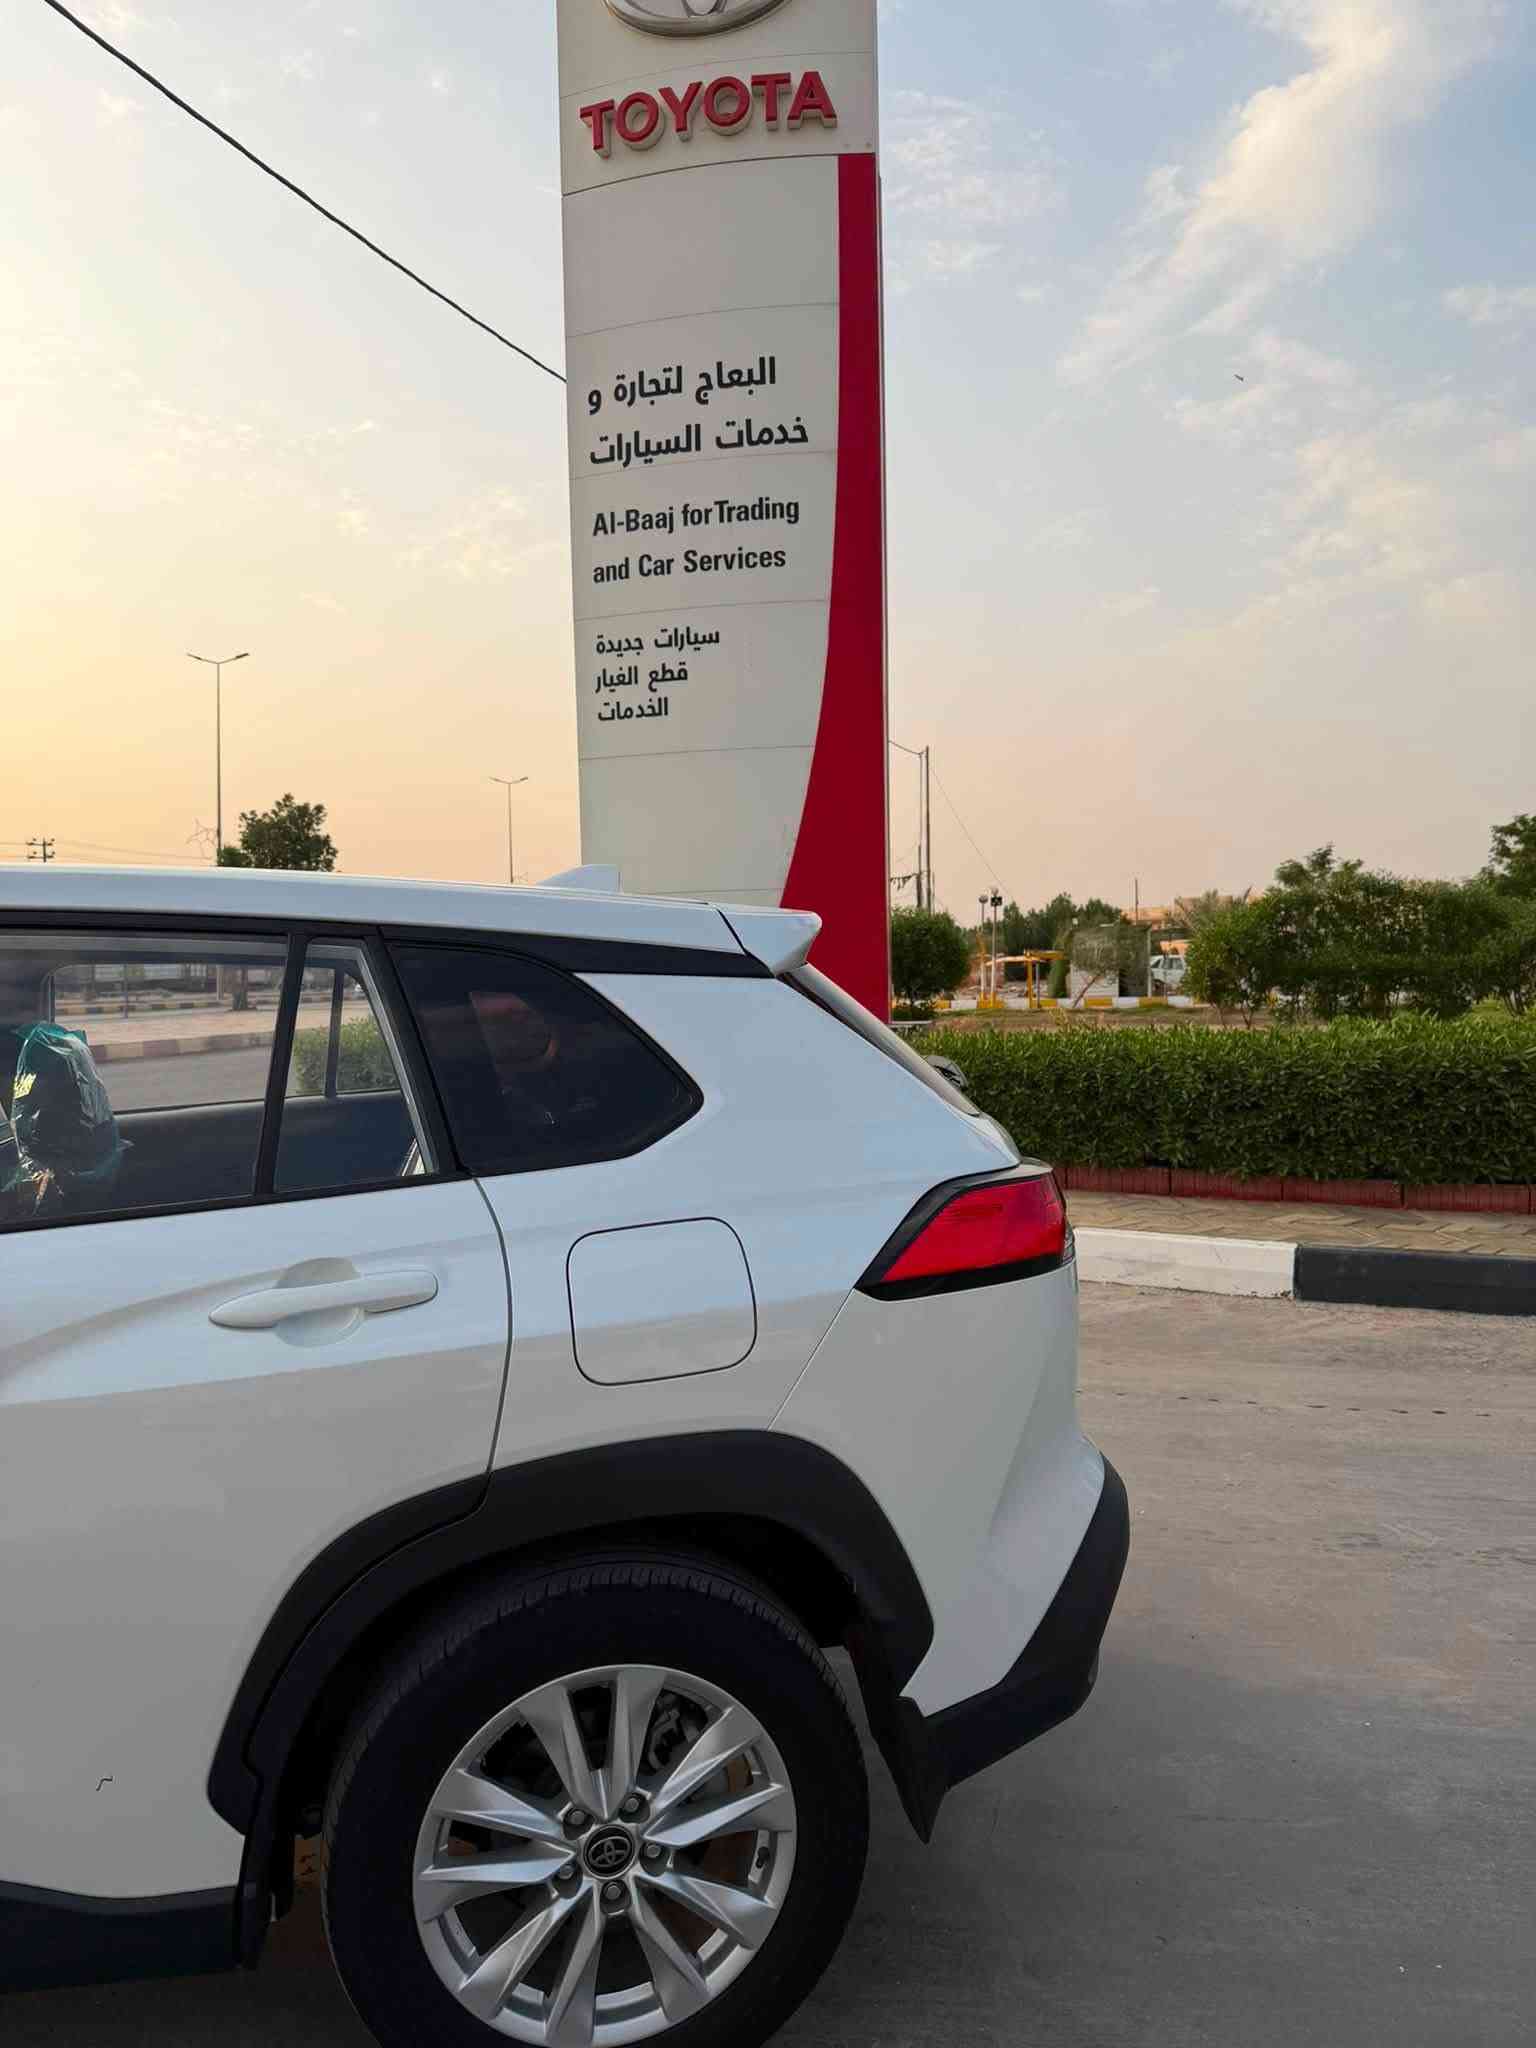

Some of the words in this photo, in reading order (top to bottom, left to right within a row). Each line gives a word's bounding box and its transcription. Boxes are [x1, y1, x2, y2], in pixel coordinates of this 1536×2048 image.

[579, 71, 838, 155] TOYOTA
[614, 366, 682, 407] لتجارة
[695, 356, 776, 405] البعاج
[588, 389, 602, 415] و
[590, 423, 701, 468] السيارات
[715, 416, 809, 449] خدمات
[592, 506, 674, 536] Al-Baaj
[682, 504, 713, 526] for
[714, 496, 800, 524] Trading
[593, 557, 630, 583] and
[638, 554, 674, 577] Car
[684, 546, 786, 573] Services
[596, 634, 644, 657] جديدة
[654, 626, 720, 652] سيارات
[595, 665, 638, 693] الغيار
[648, 661, 688, 692] قطع
[598, 697, 668, 721] الخدمات
